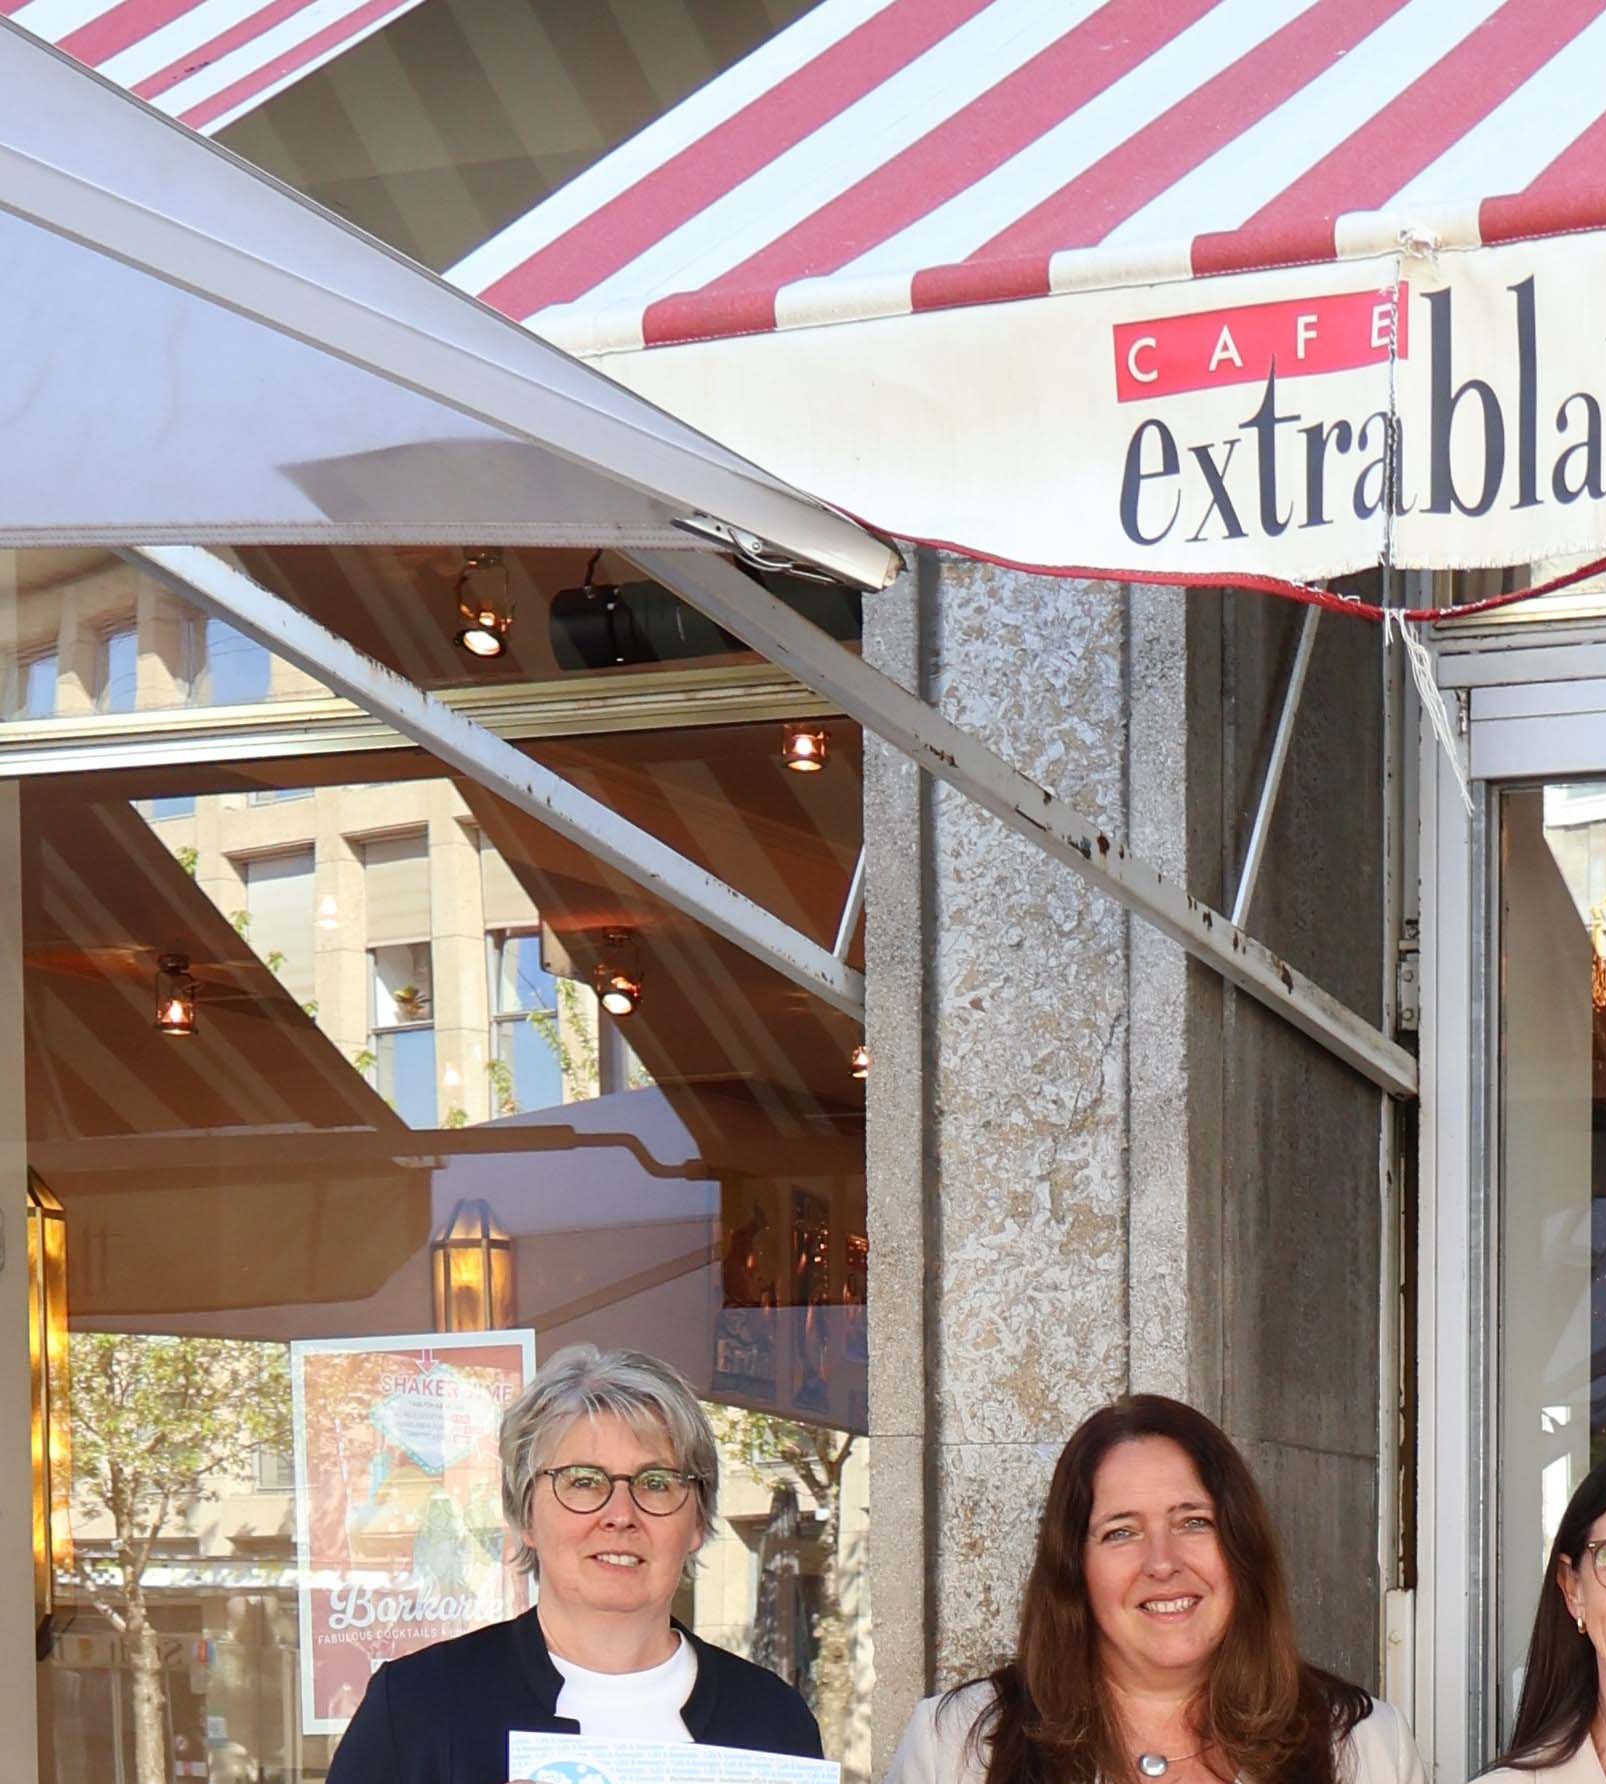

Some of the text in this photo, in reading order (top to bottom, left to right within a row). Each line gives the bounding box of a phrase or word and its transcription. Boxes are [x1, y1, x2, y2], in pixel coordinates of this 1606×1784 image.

[1127, 303, 1396, 383] CAFE
[381, 1373, 459, 1399] SHAKER
[318, 1632, 373, 1645] FABULOUS
